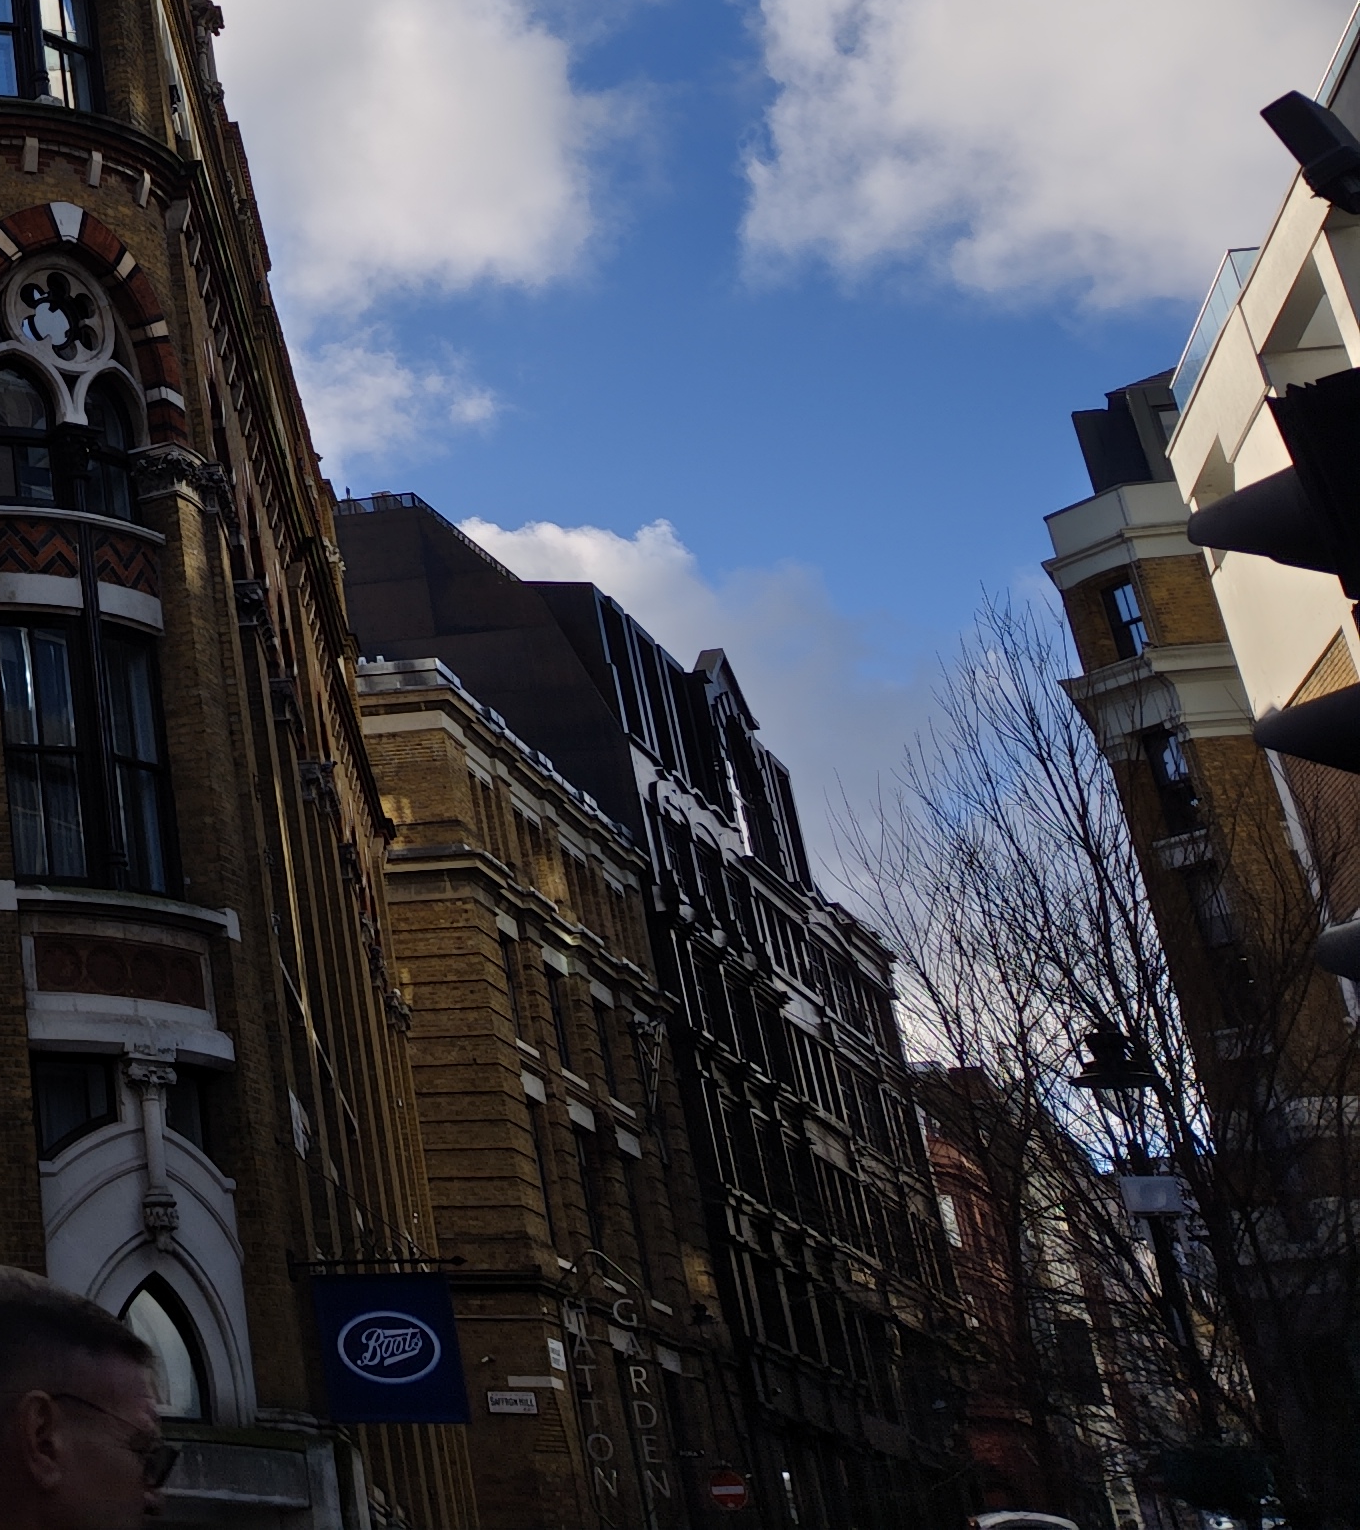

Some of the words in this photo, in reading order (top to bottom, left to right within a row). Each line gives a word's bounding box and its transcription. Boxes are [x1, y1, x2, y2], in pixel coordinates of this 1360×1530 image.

[356, 1326, 423, 1367] Boots
[563, 1297, 619, 1498] HATTON
[612, 1298, 671, 1498] GARDEN
